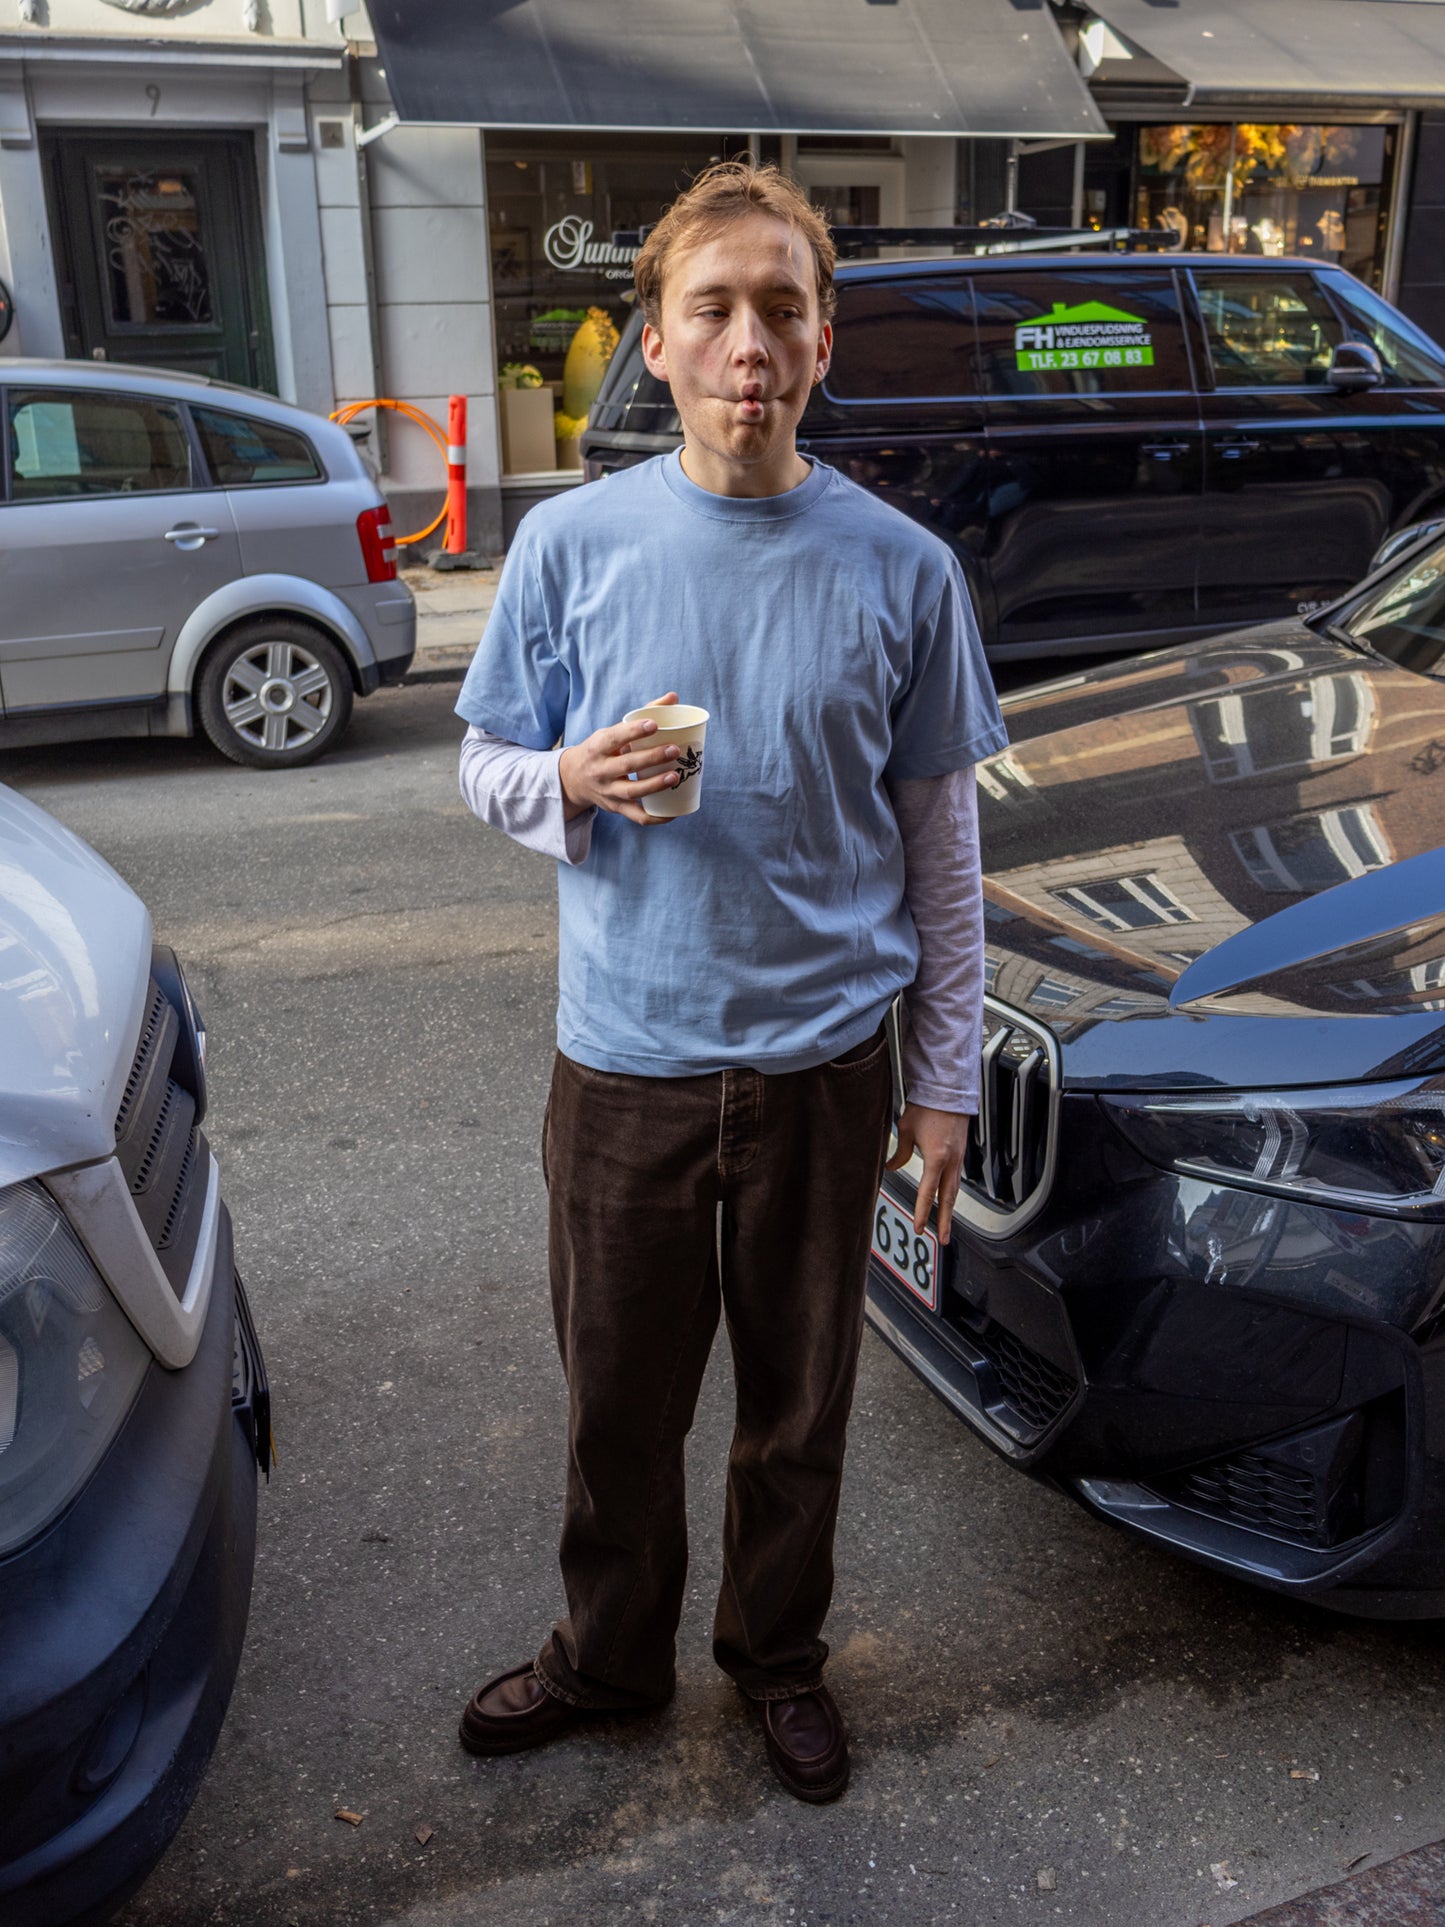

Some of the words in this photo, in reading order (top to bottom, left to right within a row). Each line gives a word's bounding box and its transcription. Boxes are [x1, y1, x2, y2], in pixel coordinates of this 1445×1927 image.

[145, 83, 161, 117] 9
[543, 214, 641, 270] Summ
[1015, 326, 1055, 350] FH
[1055, 323, 1144, 336] VINDUESPUDSNING
[1056, 337, 1064, 348] &
[1065, 333, 1152, 348] EJENDOMSSERVICE
[1028, 352, 1058, 368] TLF.
[1061, 352, 1078, 367] 23
[1082, 351, 1099, 366] 67
[1104, 350, 1122, 365] 08
[1125, 349, 1143, 365] 83
[876, 1204, 931, 1292] 638
